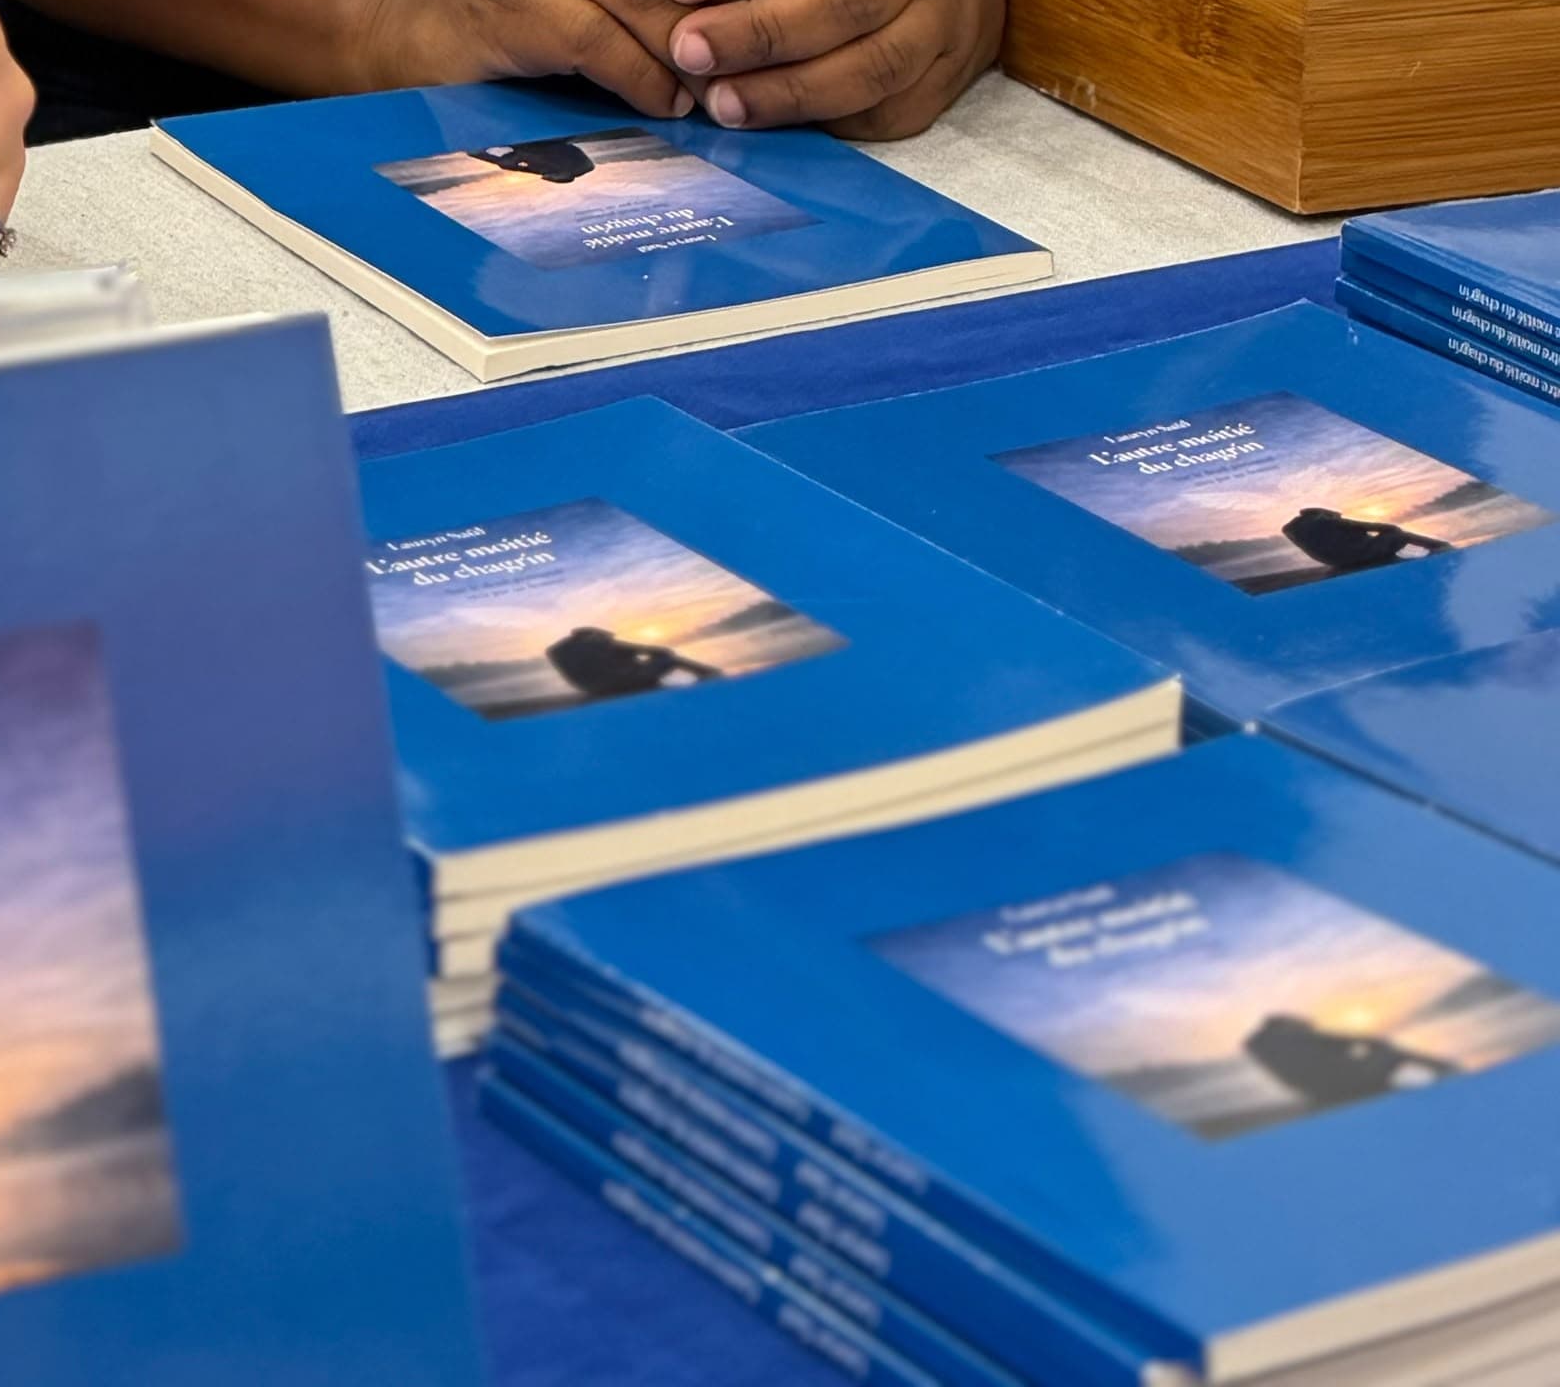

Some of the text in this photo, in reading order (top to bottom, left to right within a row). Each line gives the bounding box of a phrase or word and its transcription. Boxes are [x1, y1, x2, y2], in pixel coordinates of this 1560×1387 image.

[580, 214, 663, 234] chagrin
[664, 207, 695, 219] du
[1458, 284, 1500, 313] chagrin
[1501, 302, 1516, 320] du
[1451, 305, 1490, 333] chagrin
[1491, 324, 1505, 340] du
[1448, 337, 1488, 365] chagrin
[1488, 357, 1504, 373] du
[1178, 422, 1256, 448] moitié
[1138, 461, 1174, 475] du
[1174, 442, 1265, 467] chagrin
[364, 531, 552, 575] L'autre moitié
[413, 571, 451, 586] du
[453, 552, 557, 578] chagrin
